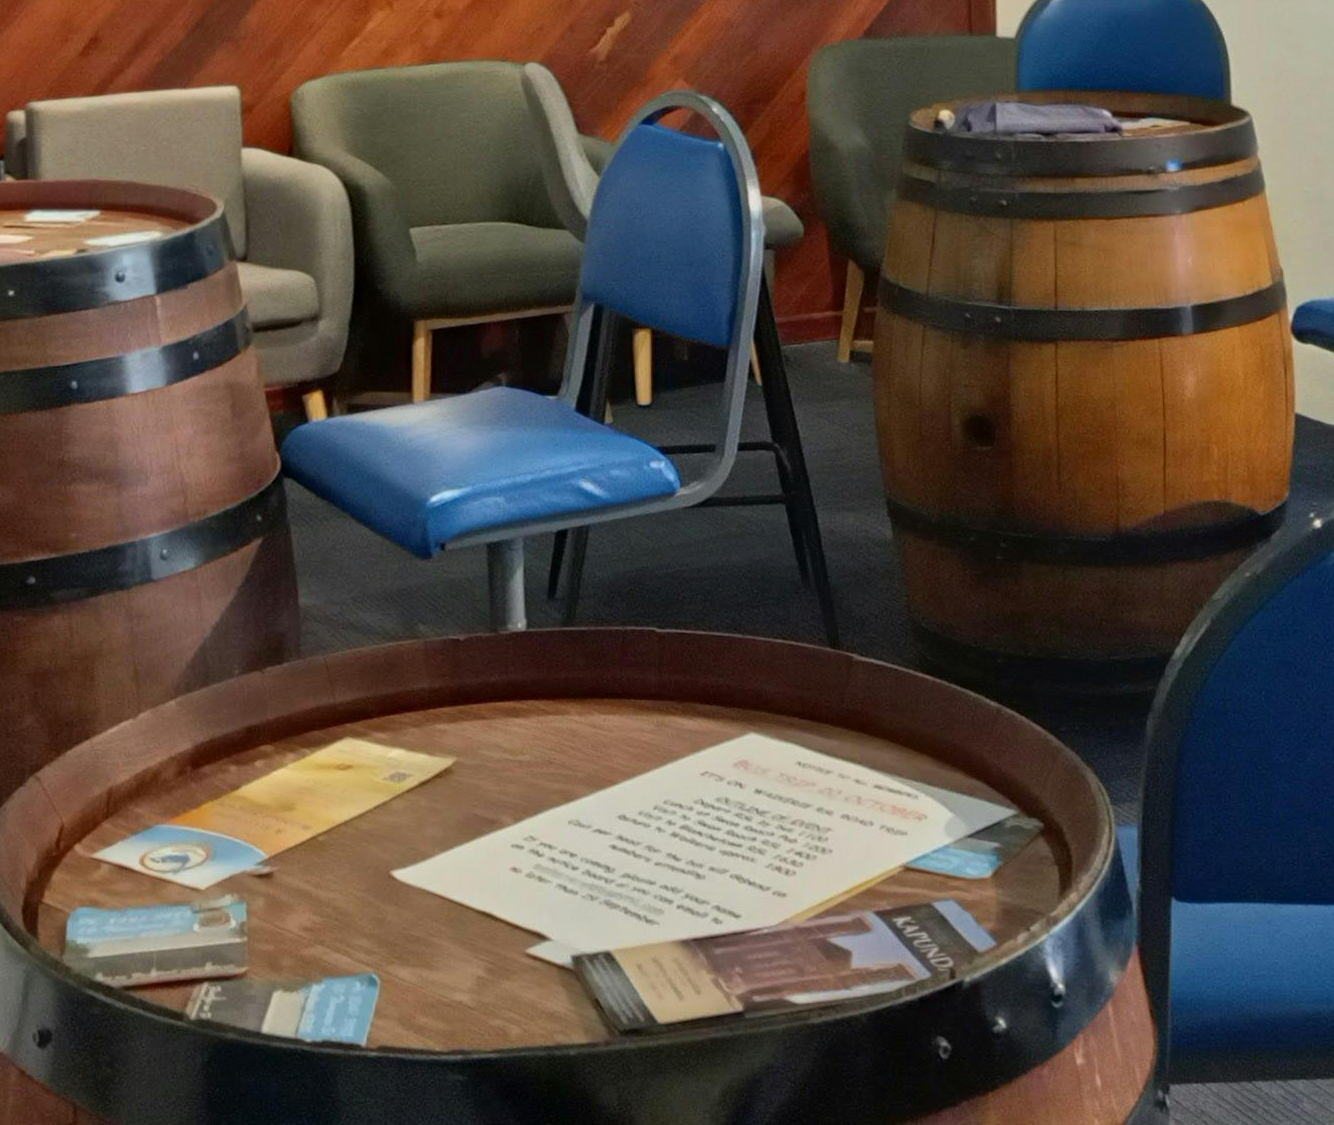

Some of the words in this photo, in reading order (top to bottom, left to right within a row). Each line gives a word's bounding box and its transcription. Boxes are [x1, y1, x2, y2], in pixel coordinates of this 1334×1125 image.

[715, 797, 770, 817] OUTLINE
[789, 819, 832, 833] EVENT
[732, 759, 772, 775] BUS
[779, 773, 818, 789] TRIP
[844, 794, 928, 822] OCTOBER
